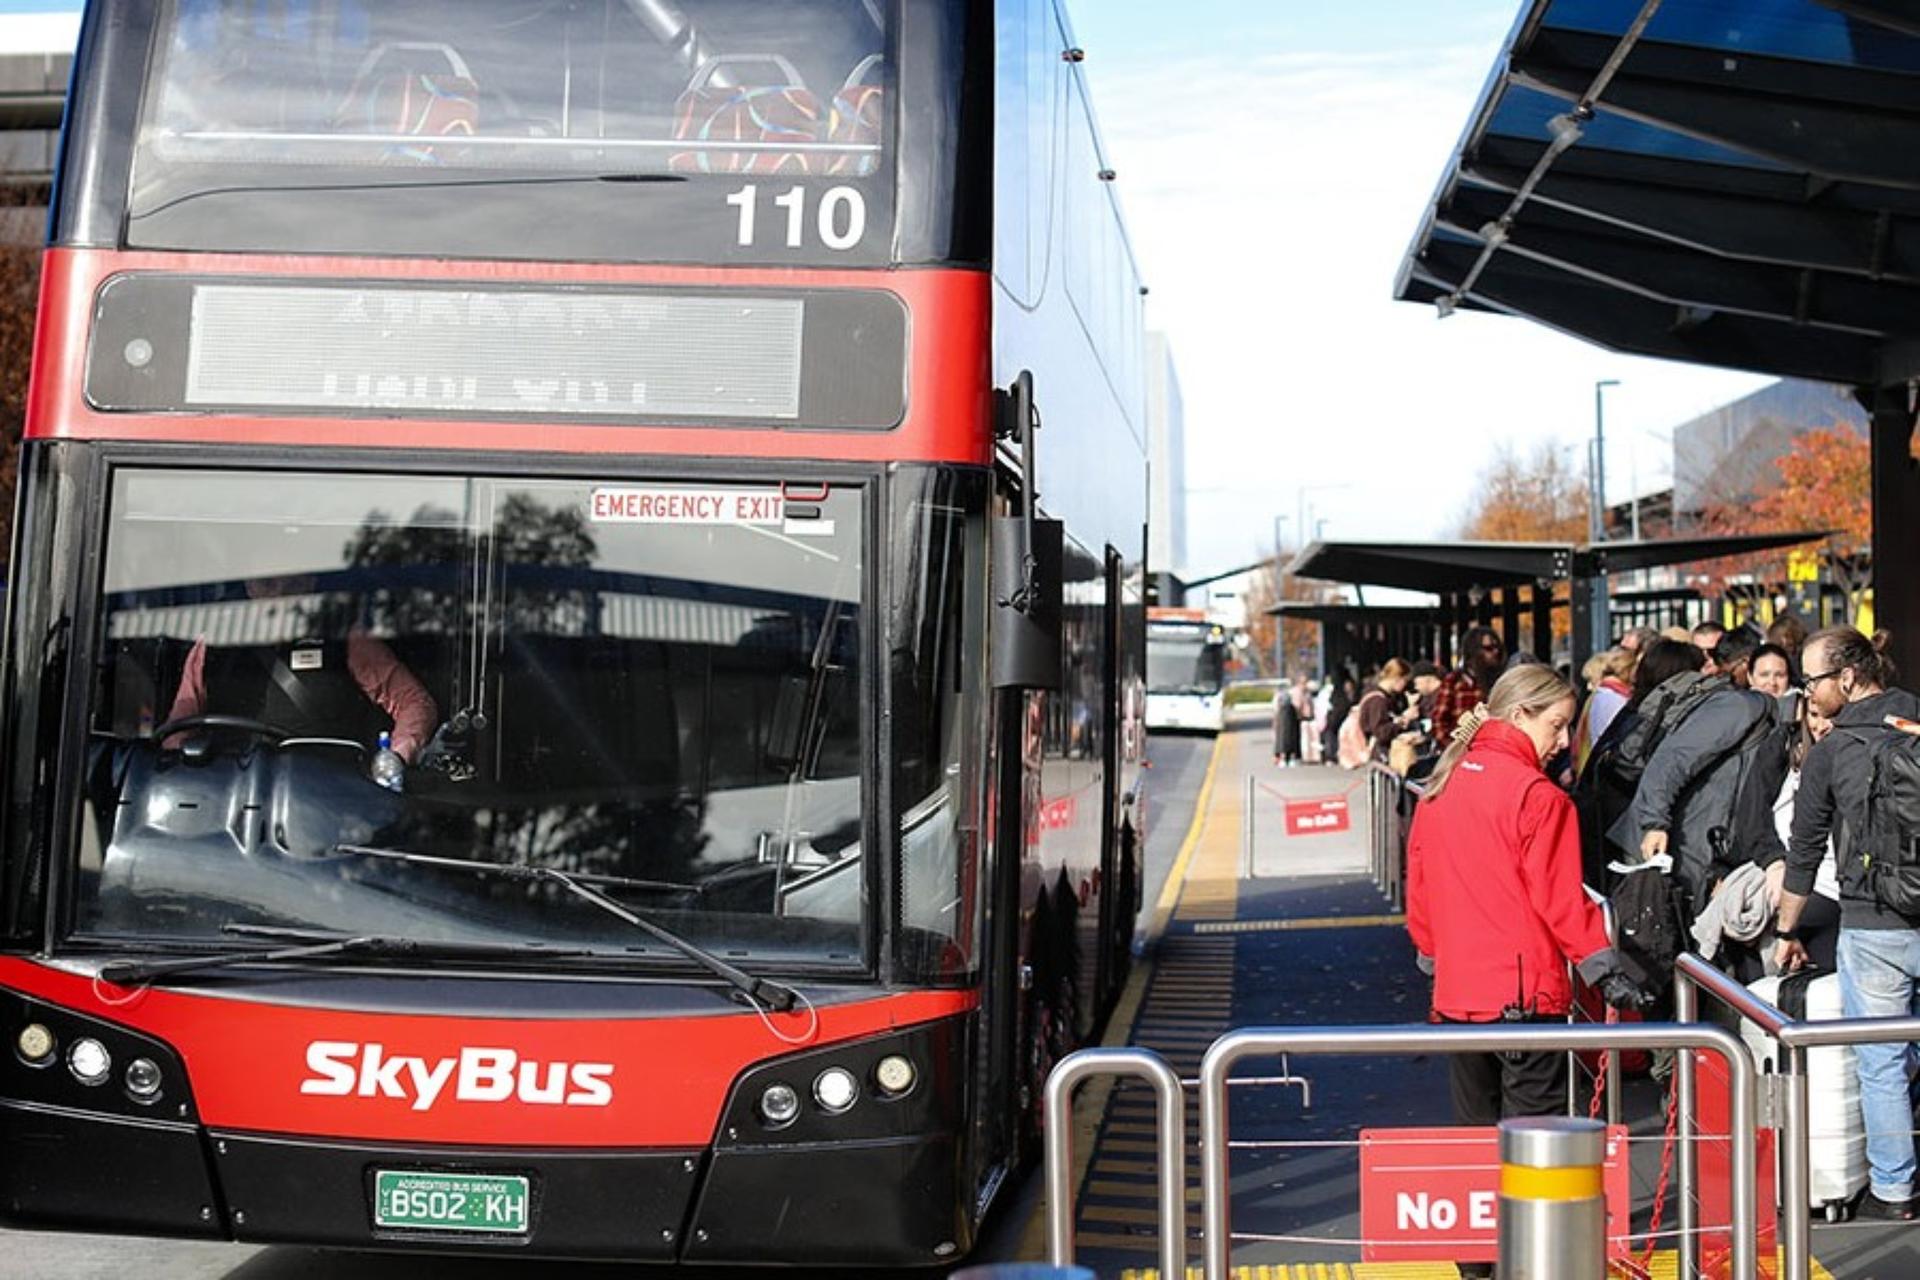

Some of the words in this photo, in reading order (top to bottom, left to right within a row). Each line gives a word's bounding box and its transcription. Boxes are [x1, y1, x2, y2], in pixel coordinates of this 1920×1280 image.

[727, 184, 866, 250] 110
[594, 493, 723, 518] EMERGENCY
[735, 496, 782, 519] EXIT
[300, 1040, 615, 1111] SkyBus
[397, 1179, 450, 1191] ACCREDITED
[452, 1181, 470, 1192] BUS
[471, 1183, 507, 1194] SERVICE
[485, 1194, 524, 1222] KH
[1396, 1192, 1458, 1229] No
